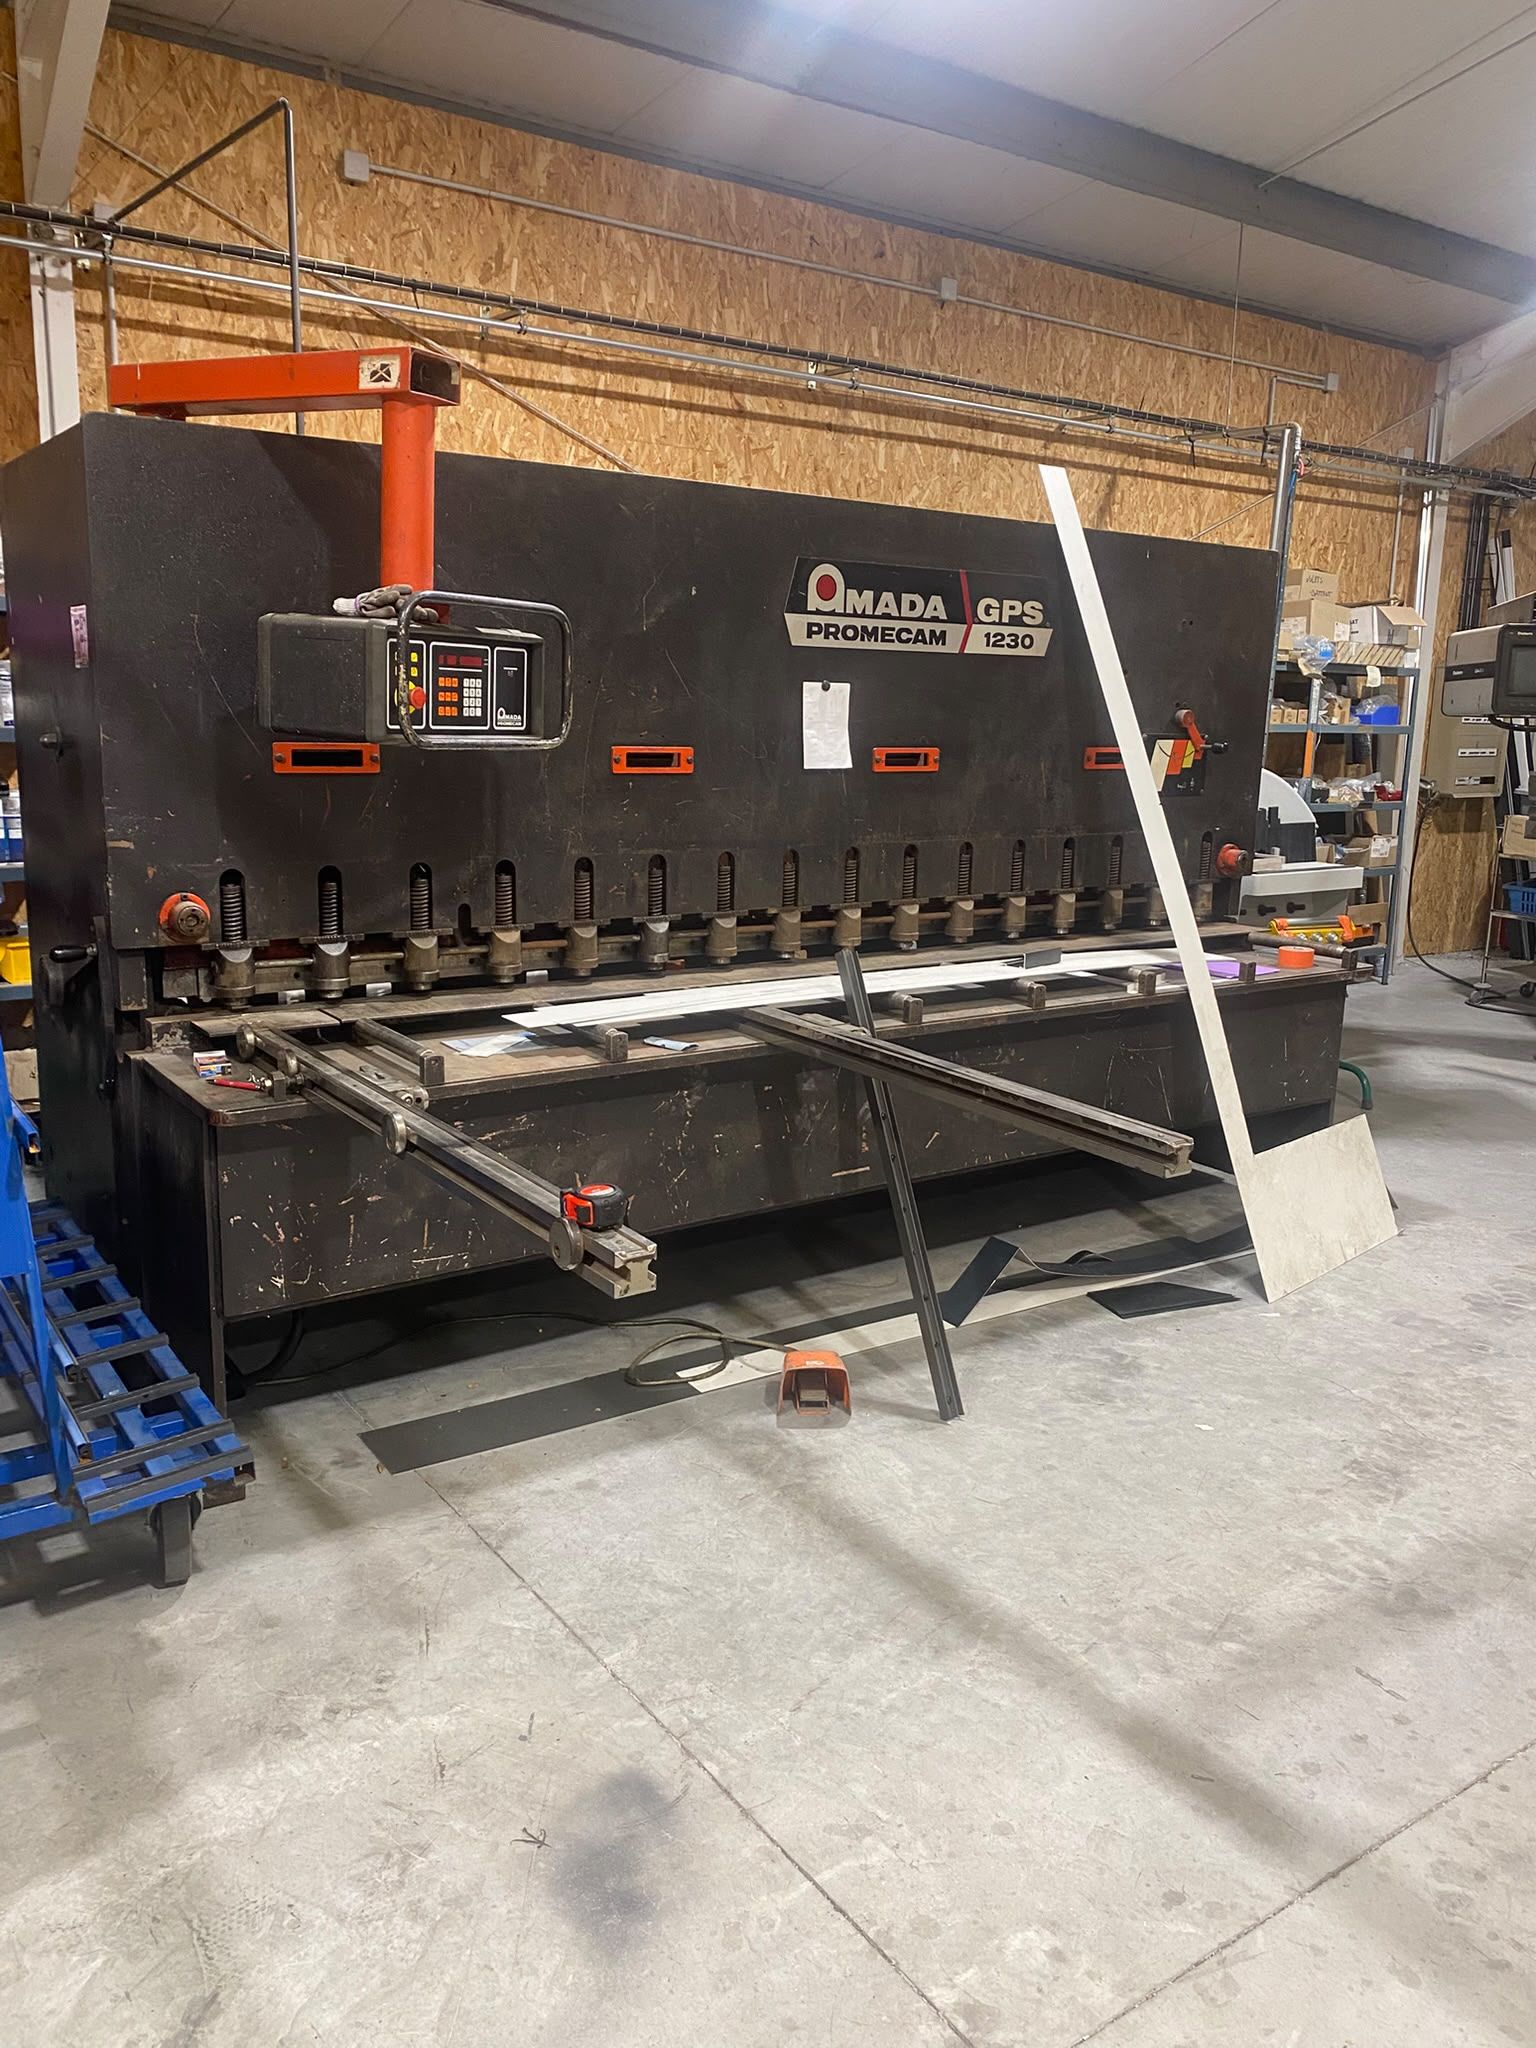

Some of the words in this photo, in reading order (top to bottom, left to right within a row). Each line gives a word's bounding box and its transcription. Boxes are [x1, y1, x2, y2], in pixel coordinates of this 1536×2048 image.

[807, 563, 948, 620] AMADA
[976, 597, 1045, 626] GPS
[806, 622, 947, 646] PROMECAM
[983, 632, 1035, 650] 1230
